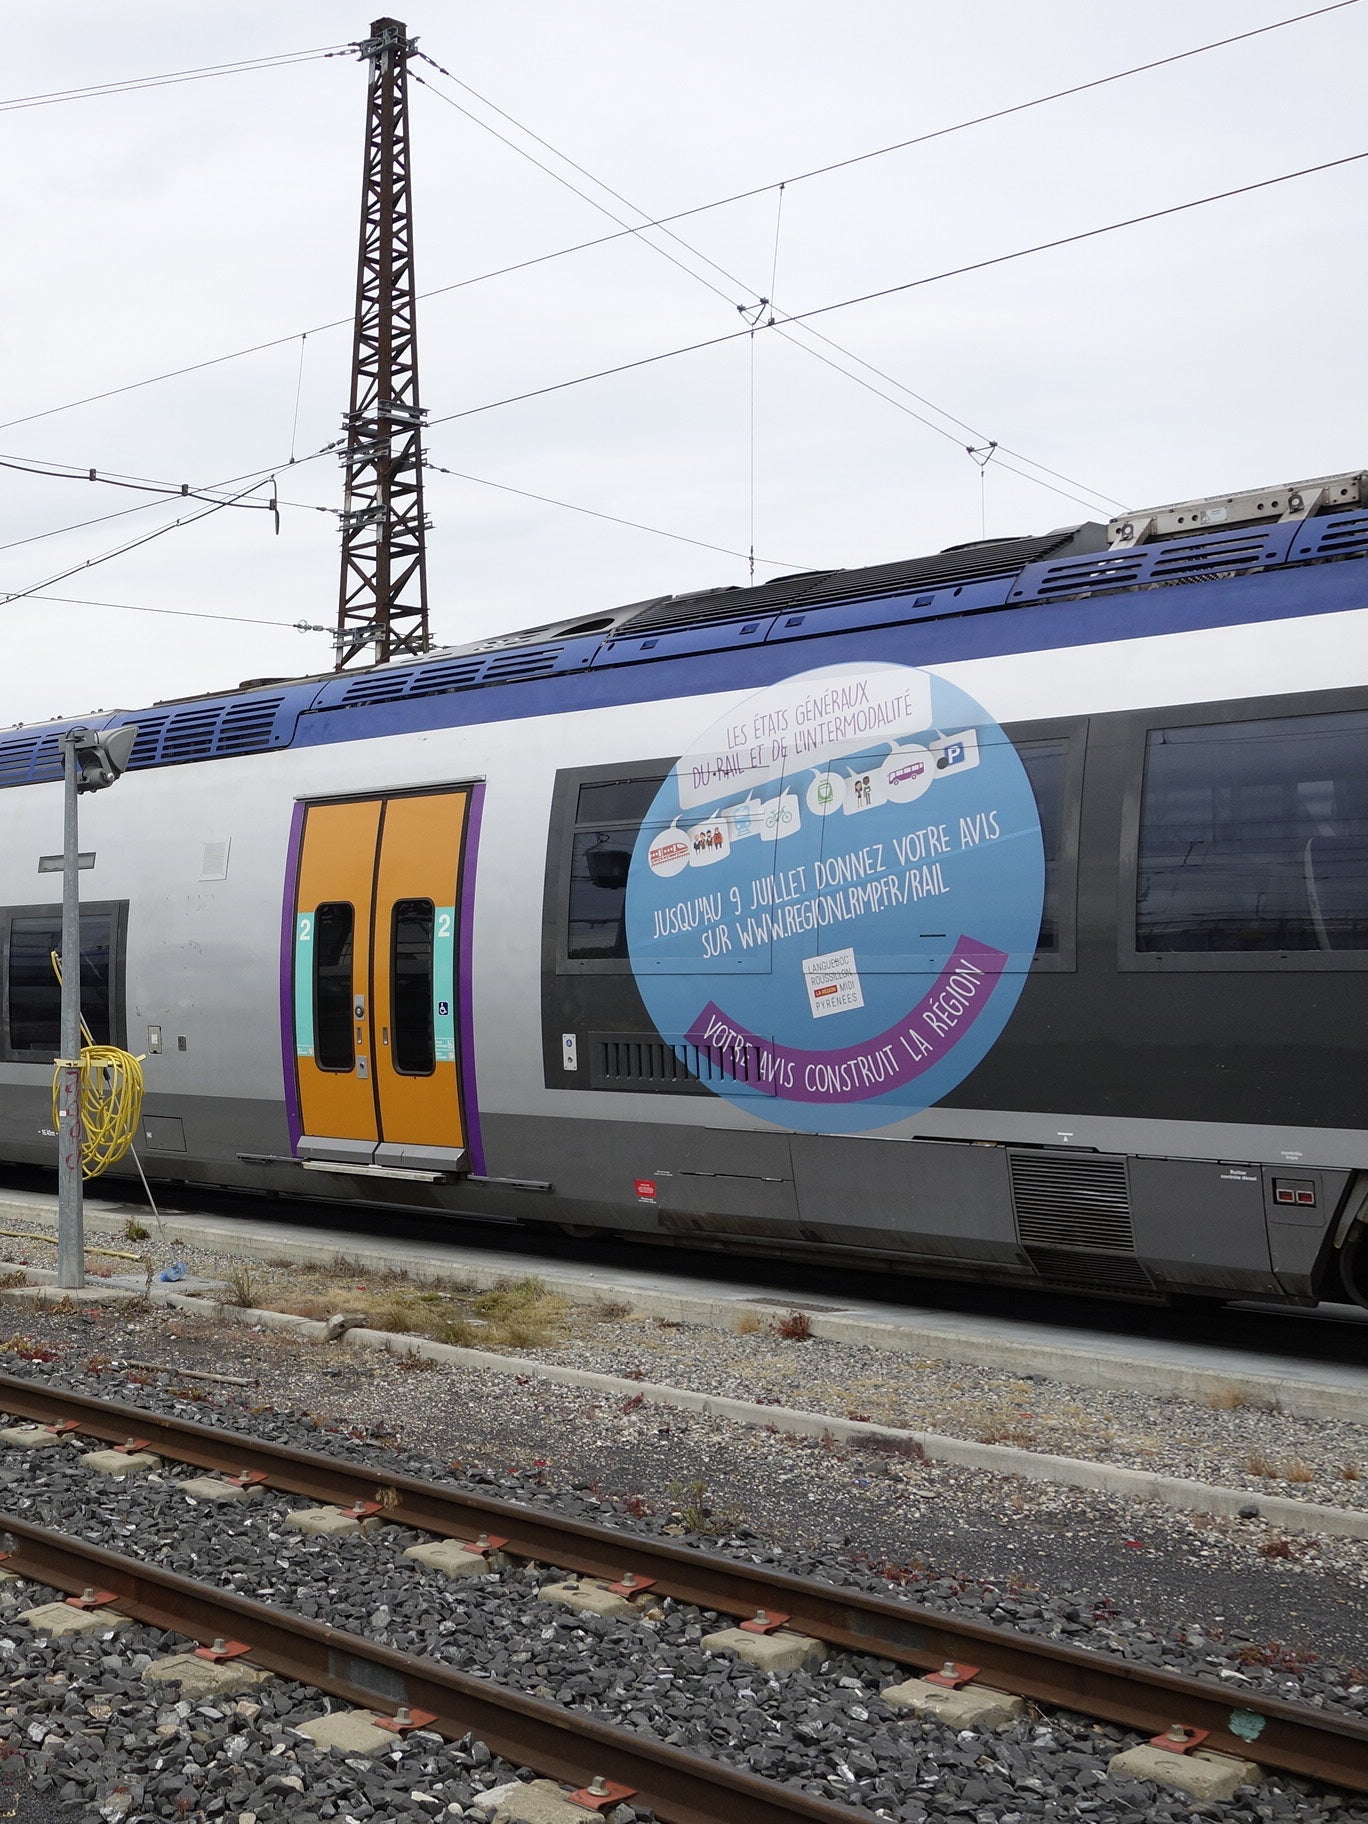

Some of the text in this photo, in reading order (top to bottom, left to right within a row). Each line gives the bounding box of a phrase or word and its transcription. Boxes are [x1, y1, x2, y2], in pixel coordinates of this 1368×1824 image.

[692, 688, 913, 790] DU RAIL ET DE L'INTERMODALITÉ
[726, 680, 870, 750] LES ÉTATS GÉNÉRAUX
[653, 810, 1001, 939] JUSQU'AU 9 JUILLET DONNEZ VOTRE AVIS
[299, 919, 311, 941] 2
[437, 914, 450, 938] 2
[701, 924, 732, 959] SUR
[839, 980, 855, 992] MIDI
[703, 958, 985, 1094] VOTRE AVIS CONSTRUIT LA RÉGION
